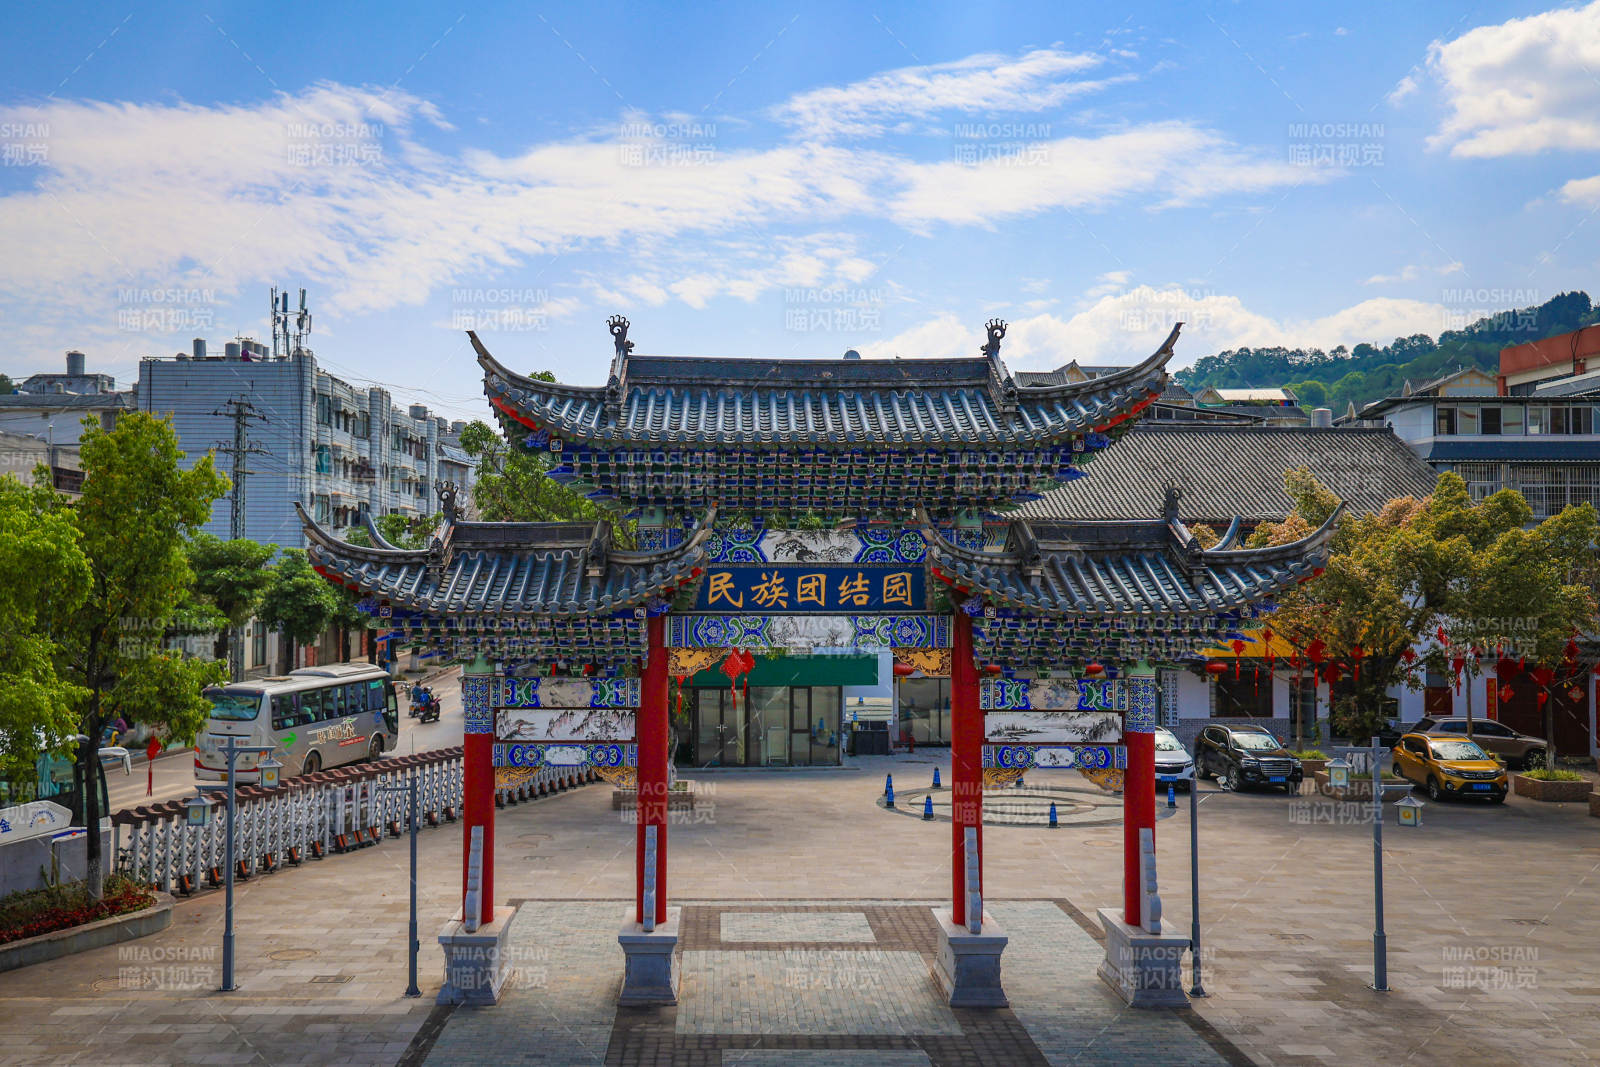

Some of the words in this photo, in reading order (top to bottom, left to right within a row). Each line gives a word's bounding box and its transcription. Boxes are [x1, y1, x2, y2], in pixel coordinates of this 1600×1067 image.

[708, 571, 914, 608] 民族团结园
